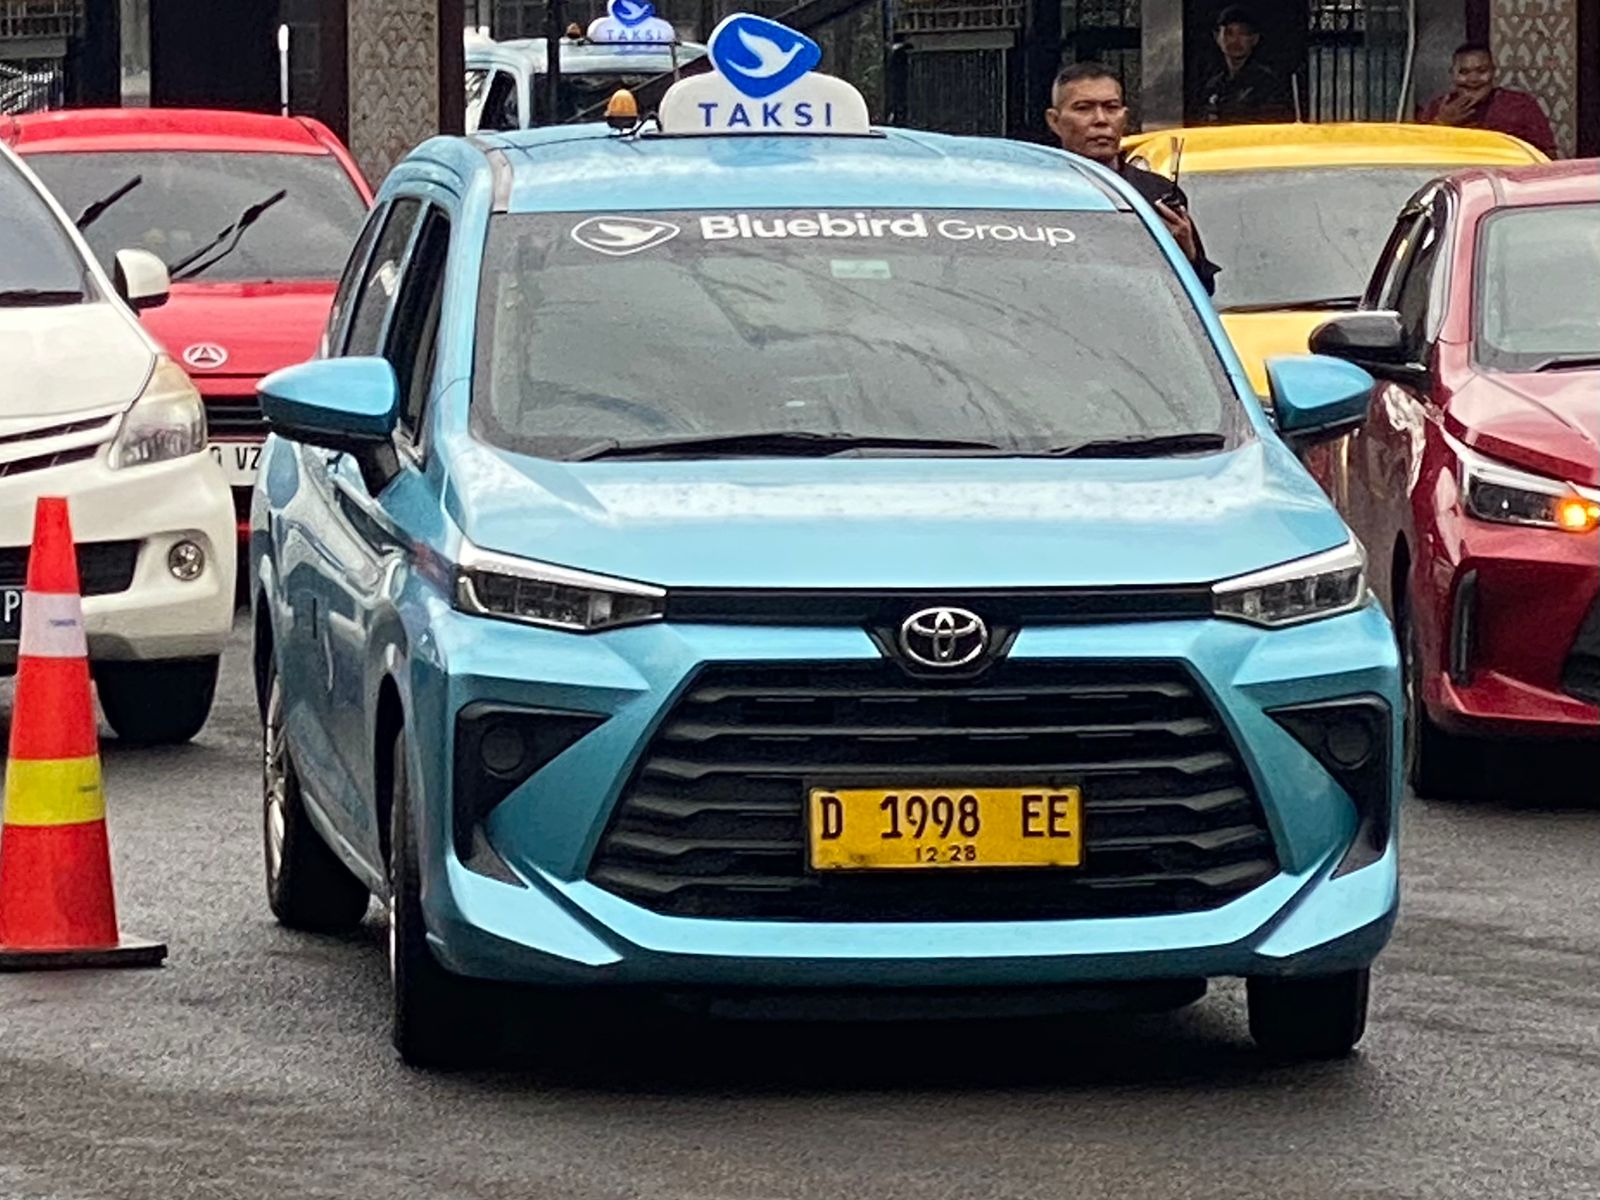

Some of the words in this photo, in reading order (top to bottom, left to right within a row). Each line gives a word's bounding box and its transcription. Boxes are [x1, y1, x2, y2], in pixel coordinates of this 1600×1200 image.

[606, 29, 663, 41] TAKSI
[697, 102, 832, 128] TAKSI
[700, 212, 928, 240] Bluebird
[937, 218, 1076, 246] Group
[820, 796, 844, 840] D
[880, 795, 981, 840] 1998
[1021, 794, 1072, 838] EE
